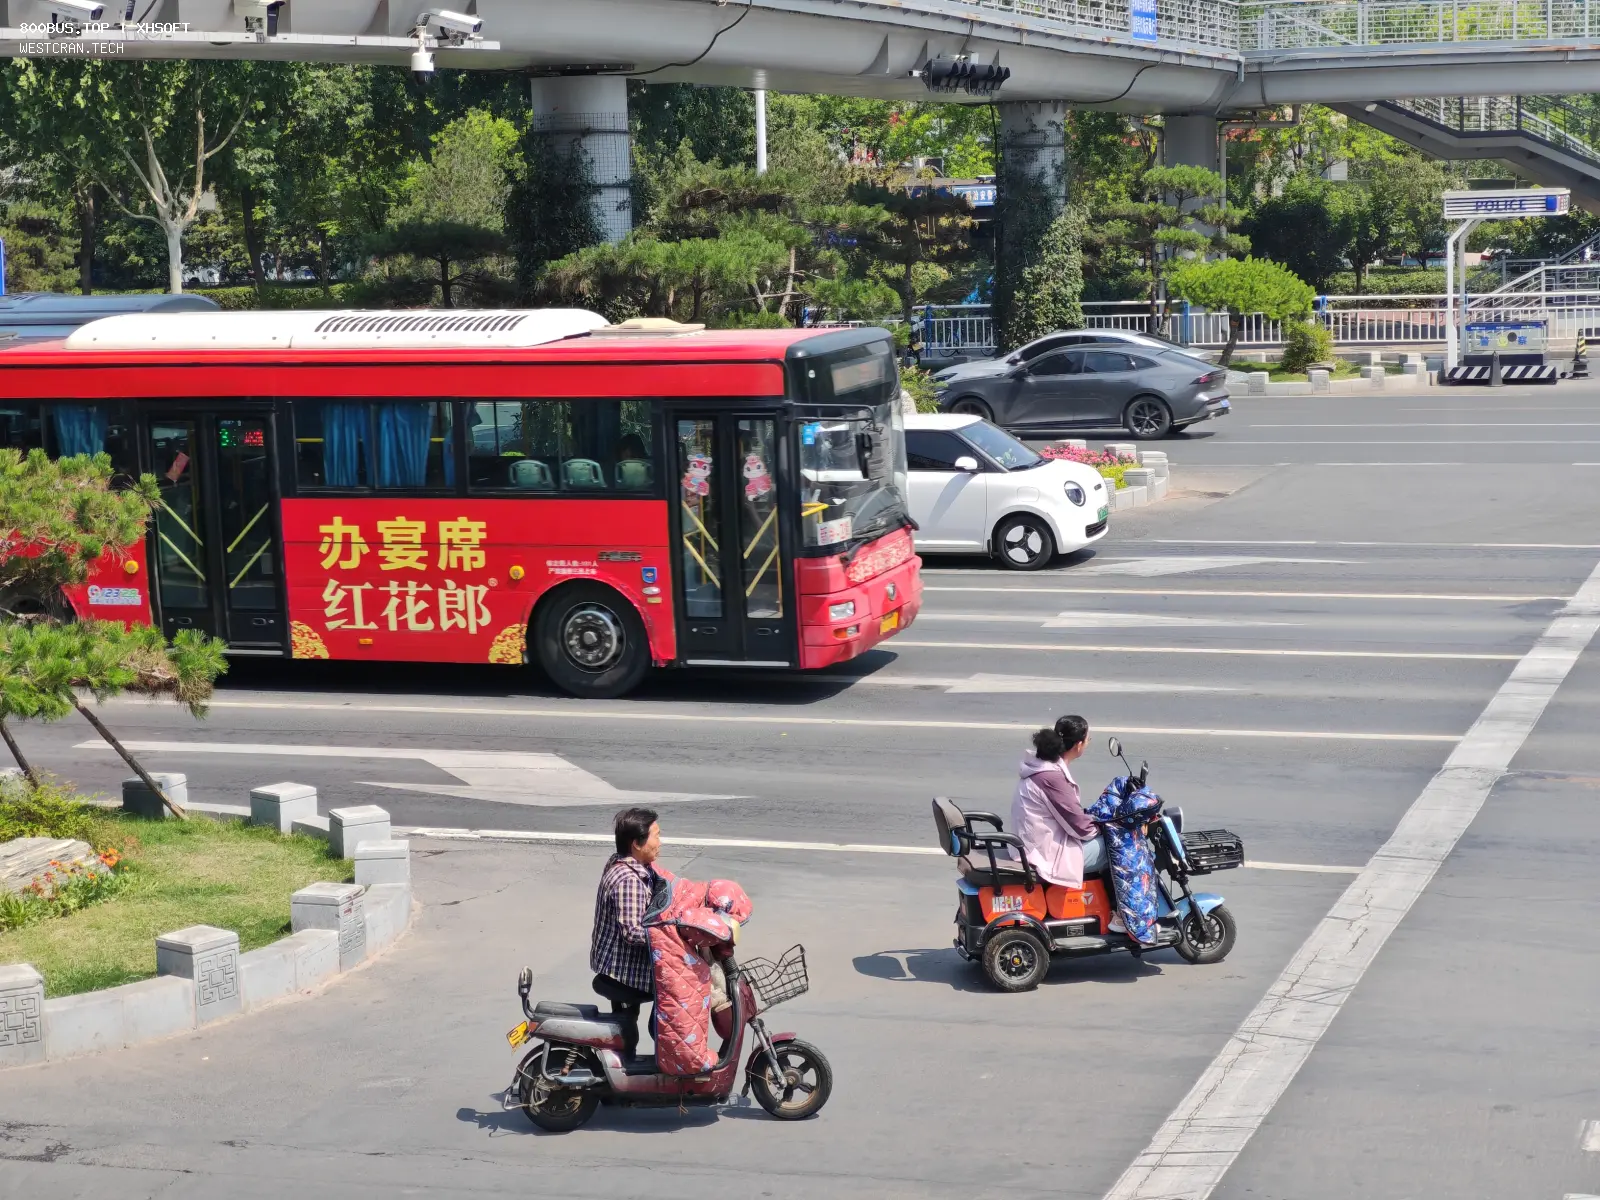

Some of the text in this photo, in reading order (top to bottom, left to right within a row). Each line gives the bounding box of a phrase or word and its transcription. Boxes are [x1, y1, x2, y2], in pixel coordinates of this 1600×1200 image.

[1475, 200, 1526, 212] POLICE
[318, 516, 488, 572] 办宴席
[321, 578, 492, 635] 红花郎
[992, 895, 1023, 913] HELLO
